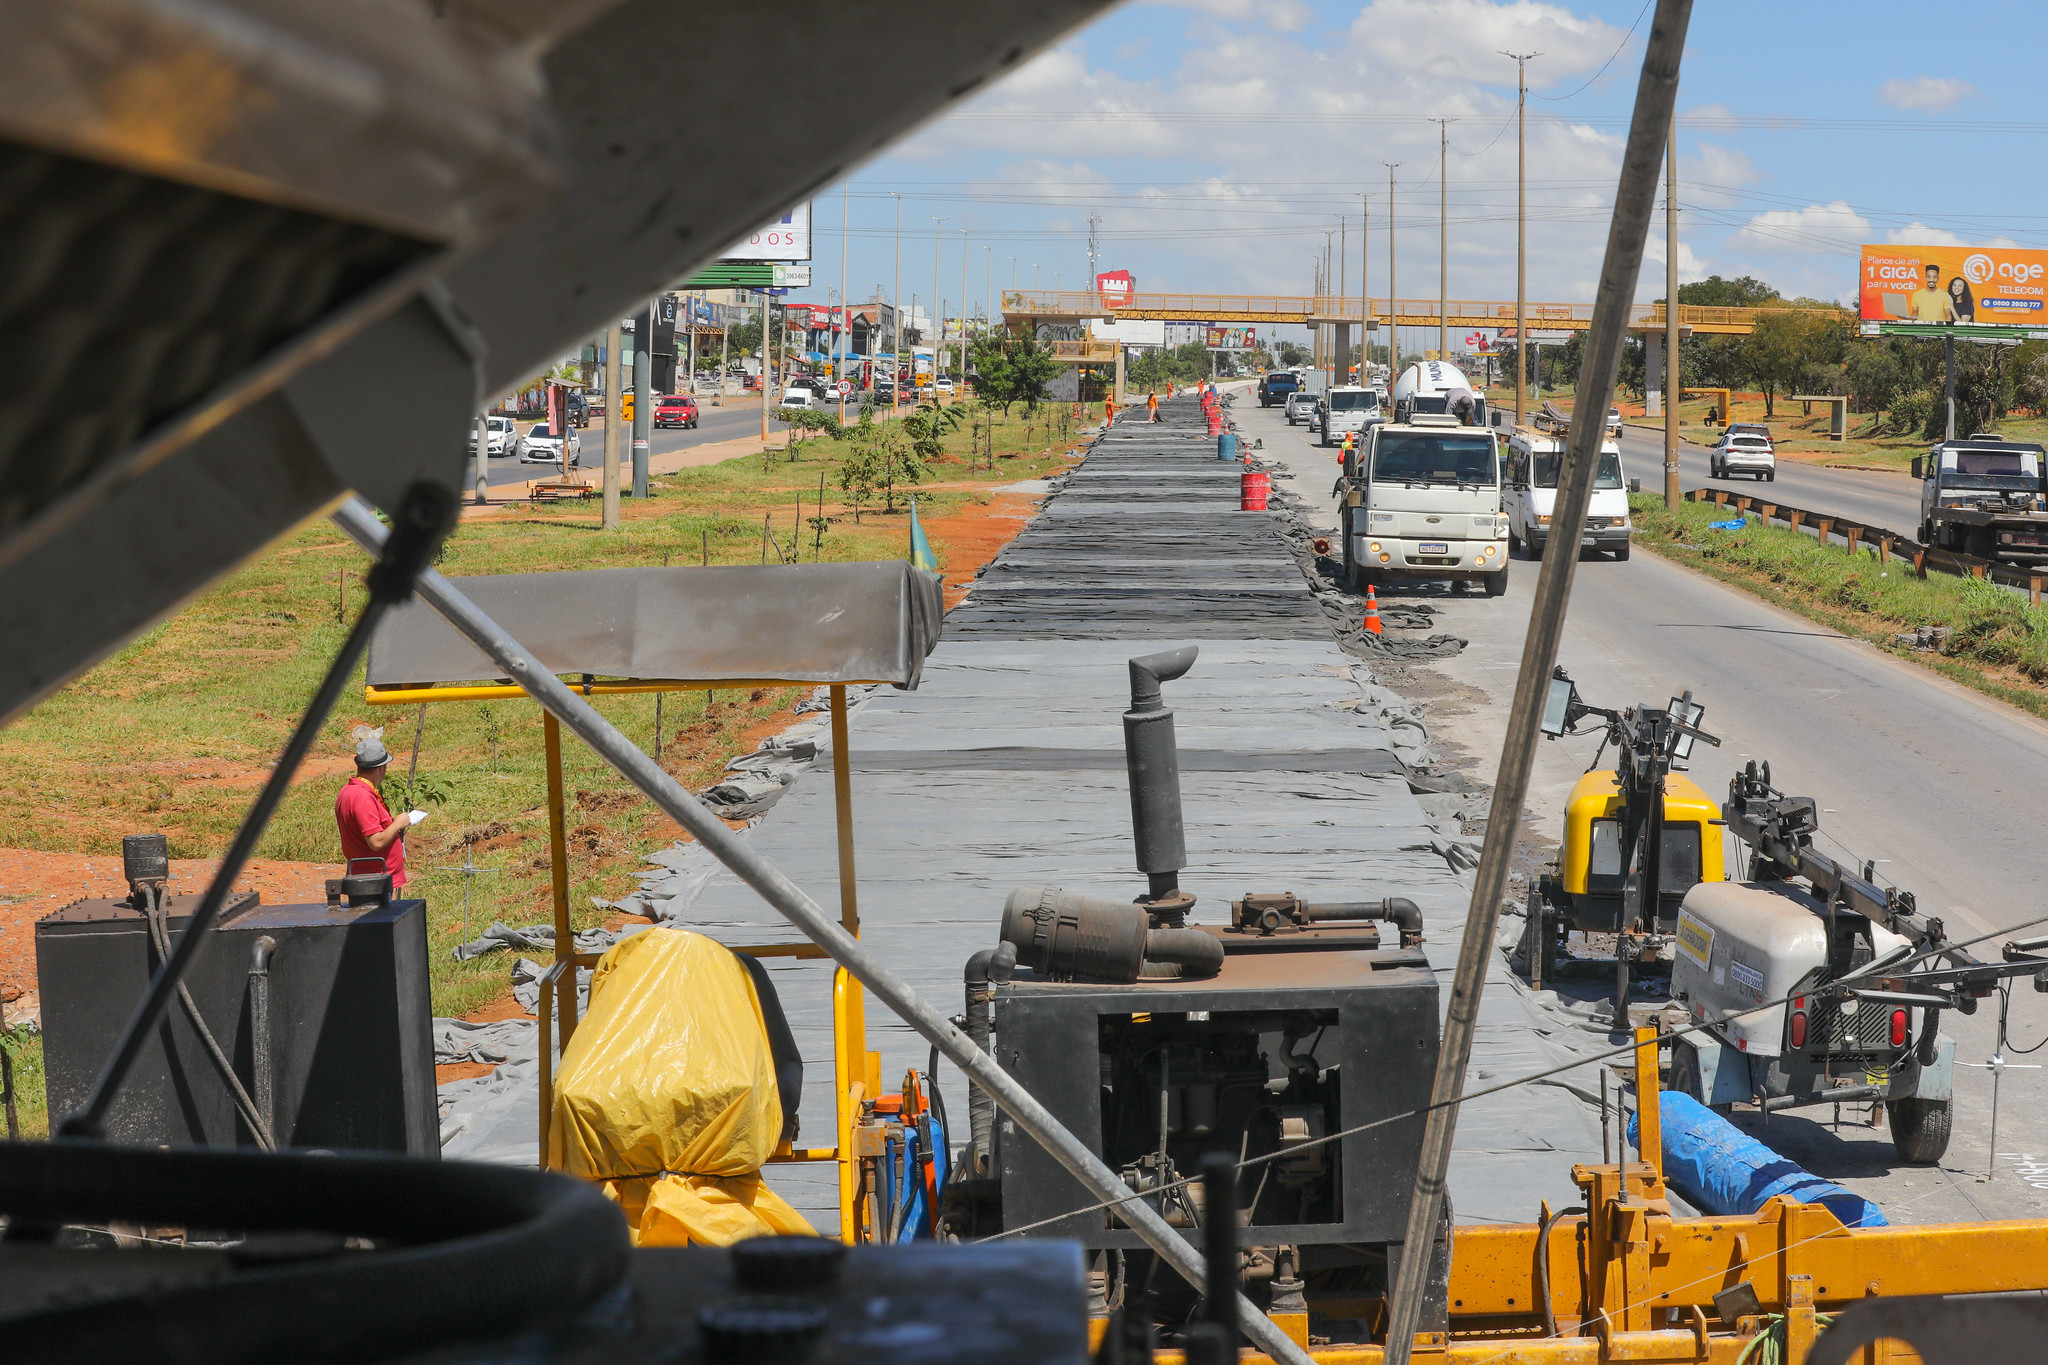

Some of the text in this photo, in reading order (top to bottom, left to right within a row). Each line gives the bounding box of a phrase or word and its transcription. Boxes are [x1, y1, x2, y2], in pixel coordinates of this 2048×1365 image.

[1867, 256, 1921, 265] Planos de até
[1867, 266, 1919, 280] 1 GIGA
[1998, 262, 2045, 284] age
[1866, 281, 1917, 290] para VOCÊ!
[1998, 285, 2044, 296] TELECOM
[1683, 927, 1708, 954] GERADORA
